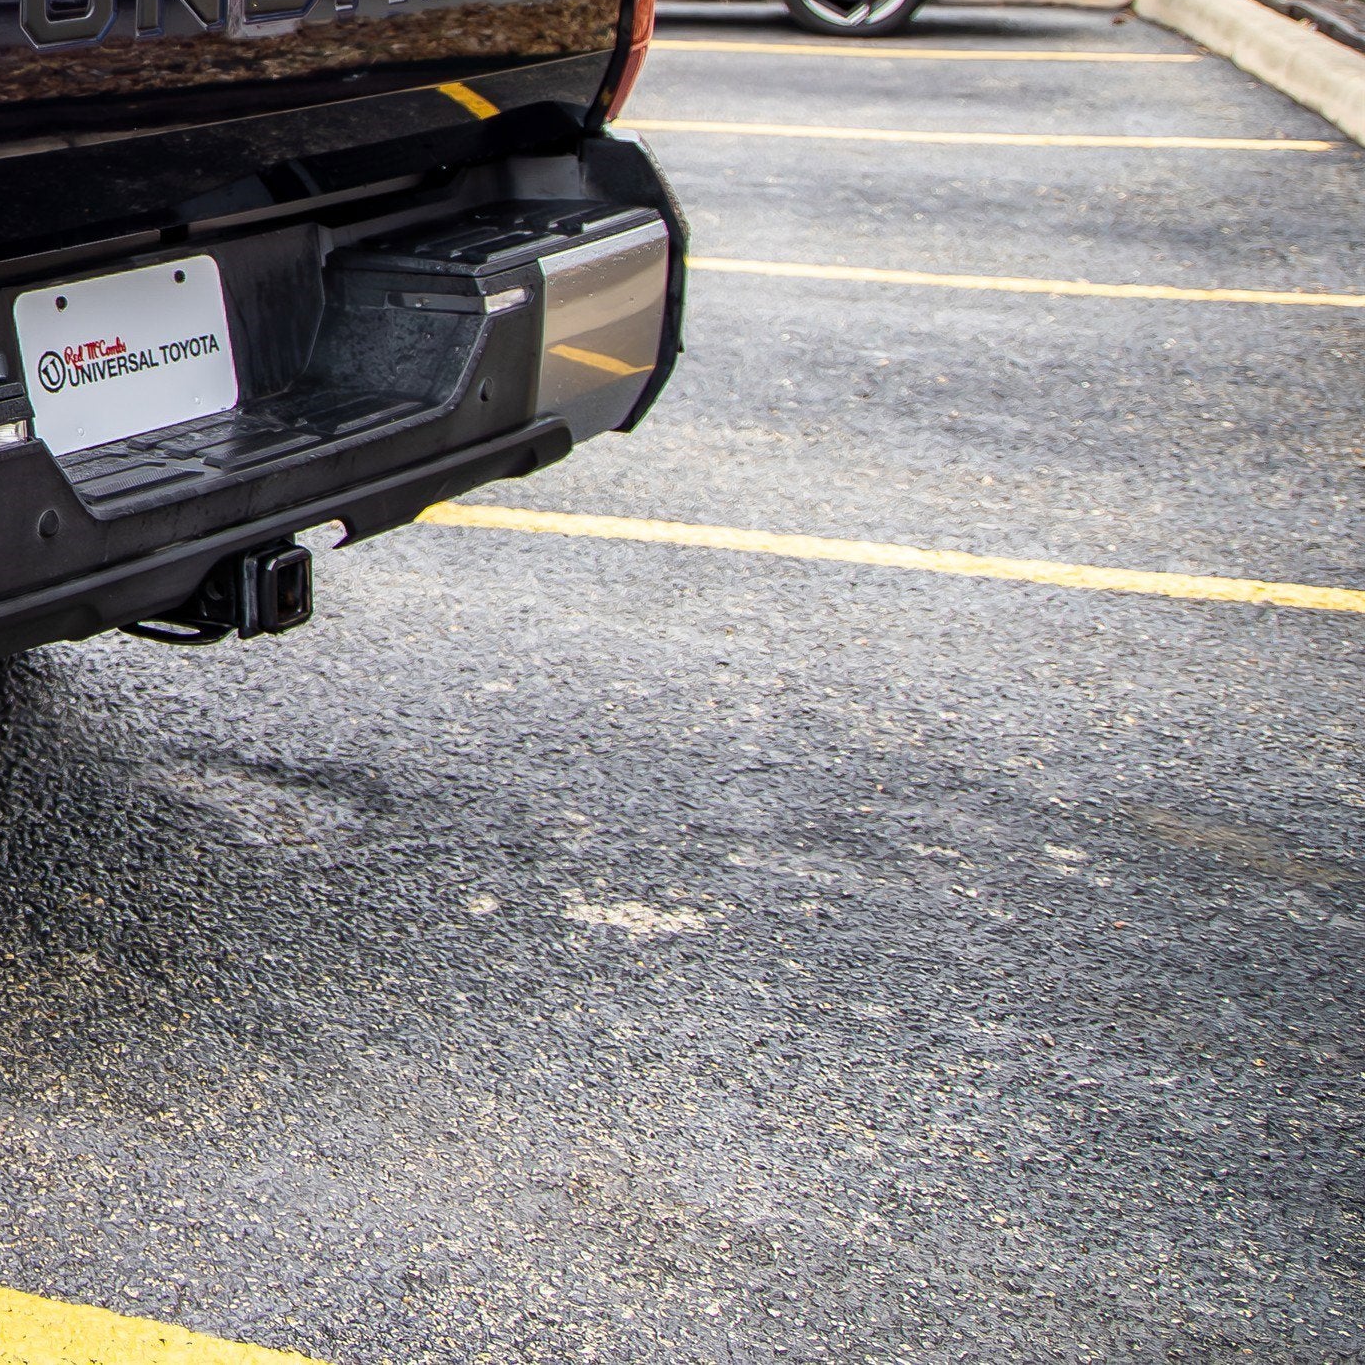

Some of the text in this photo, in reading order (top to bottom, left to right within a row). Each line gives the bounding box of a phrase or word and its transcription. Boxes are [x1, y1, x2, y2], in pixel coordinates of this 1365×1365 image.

[64, 345, 84, 369] Red
[68, 333, 220, 387] UNIVERSAL TOYOTA
